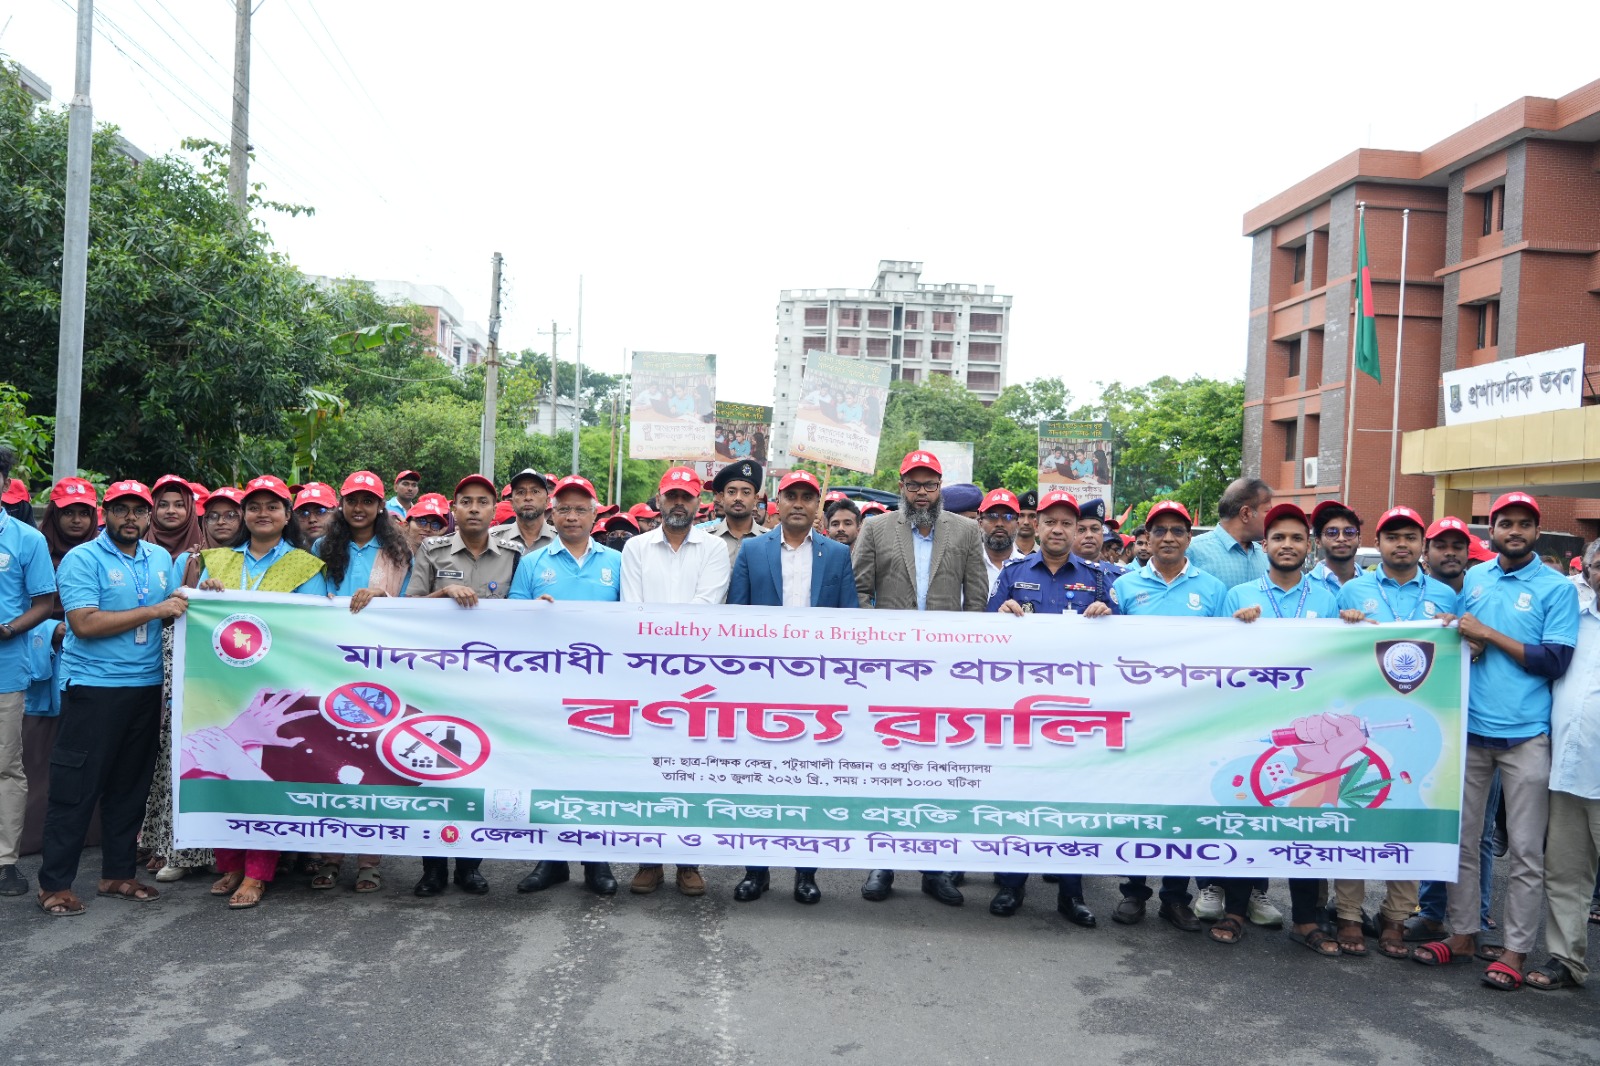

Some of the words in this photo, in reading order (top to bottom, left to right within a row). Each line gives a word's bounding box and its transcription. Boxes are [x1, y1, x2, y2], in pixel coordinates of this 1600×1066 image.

[1468, 371, 1534, 409] প্রশাসনিক
[1538, 367, 1577, 395] ভবন
[637, 621, 712, 641] Healthy
[717, 623, 779, 640] Minds
[782, 624, 810, 640] for
[814, 630, 825, 641] a
[829, 626, 906, 646] Brighter
[911, 628, 1013, 645] Tomorrow
[337, 641, 613, 676] মাদকবিরোধী
[622, 652, 938, 690] সচেতনতামূলক
[949, 658, 1103, 687] প্রচারণা
[1115, 656, 1313, 691] উপলক্ষ্যে
[562, 684, 850, 744] বর্ণাঢ্য
[661, 769, 697, 782] তারিখ
[708, 773, 727, 783] ২৩
[730, 772, 764, 785] জুলাই
[767, 774, 802, 785] ২০২৬
[832, 776, 859, 786] সময়
[870, 777, 903, 787] সকাল
[906, 779, 943, 787] ১০:০০
[947, 777, 983, 789] ঘটিকা
[781, 757, 835, 772] পটুয়াখালী
[838, 758, 874, 771] বিজ্ঞান
[877, 762, 888, 771] ও
[890, 760, 924, 774] প্রযুক্তি
[926, 761, 993, 774] বিশ্ববিদ্যালয়
[286, 790, 454, 812] আয়োজনে
[533, 796, 696, 823] পটুয়াখালী
[702, 799, 812, 824] বিজ্ঞান
[822, 806, 850, 822] ও
[861, 804, 961, 829] প্রযুক্তি
[1196, 810, 1357, 838] পটুয়াখালী
[226, 818, 411, 841] সহযোগিতায়
[470, 827, 549, 845] জেলা
[557, 828, 668, 848] প্রশাসন
[677, 834, 702, 847] ও
[712, 832, 856, 854] মাদকদ্রব্য
[863, 832, 963, 856] নিয়ন্ত্রণ
[971, 834, 1103, 859] অধিদপ্তর
[1267, 840, 1415, 867] পটুয়াখালী
